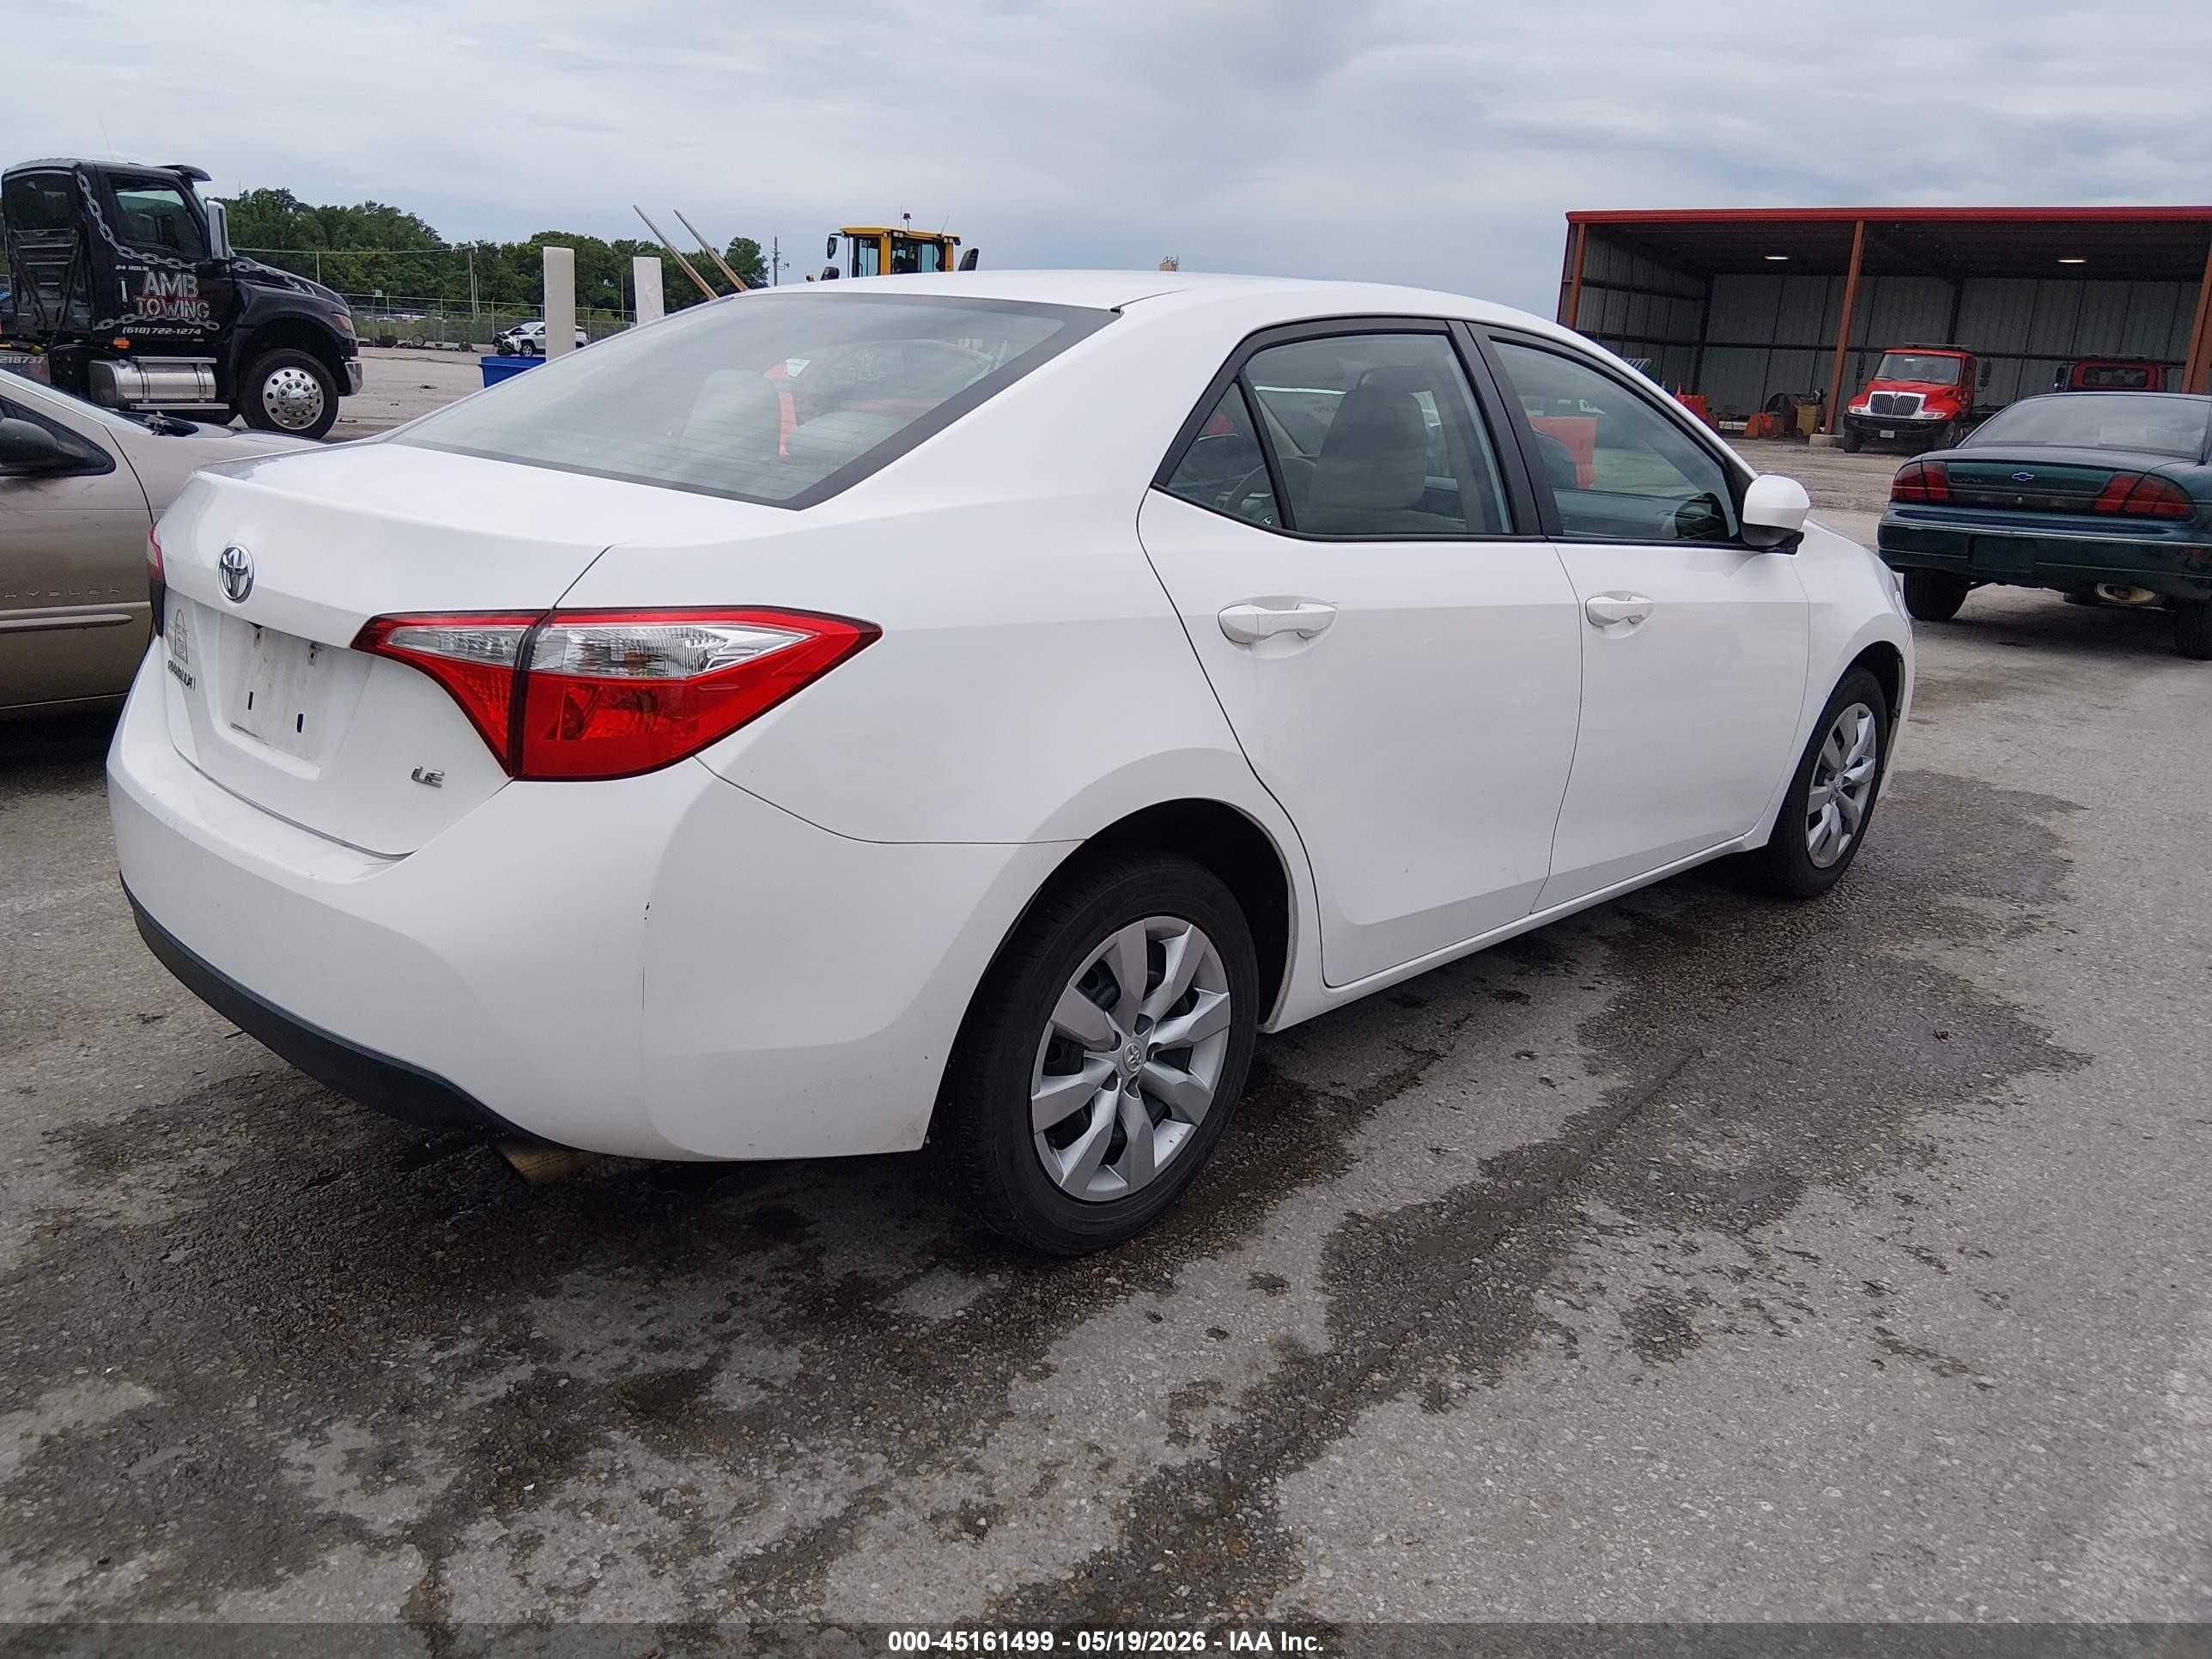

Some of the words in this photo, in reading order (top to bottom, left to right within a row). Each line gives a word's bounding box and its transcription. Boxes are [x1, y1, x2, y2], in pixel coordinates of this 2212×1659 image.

[143, 271, 198, 298] AMB
[135, 296, 210, 319] TOWING
[122, 326, 150, 335] (618)
[0, 356, 45, 364] 218737
[411, 764, 445, 788] LE
